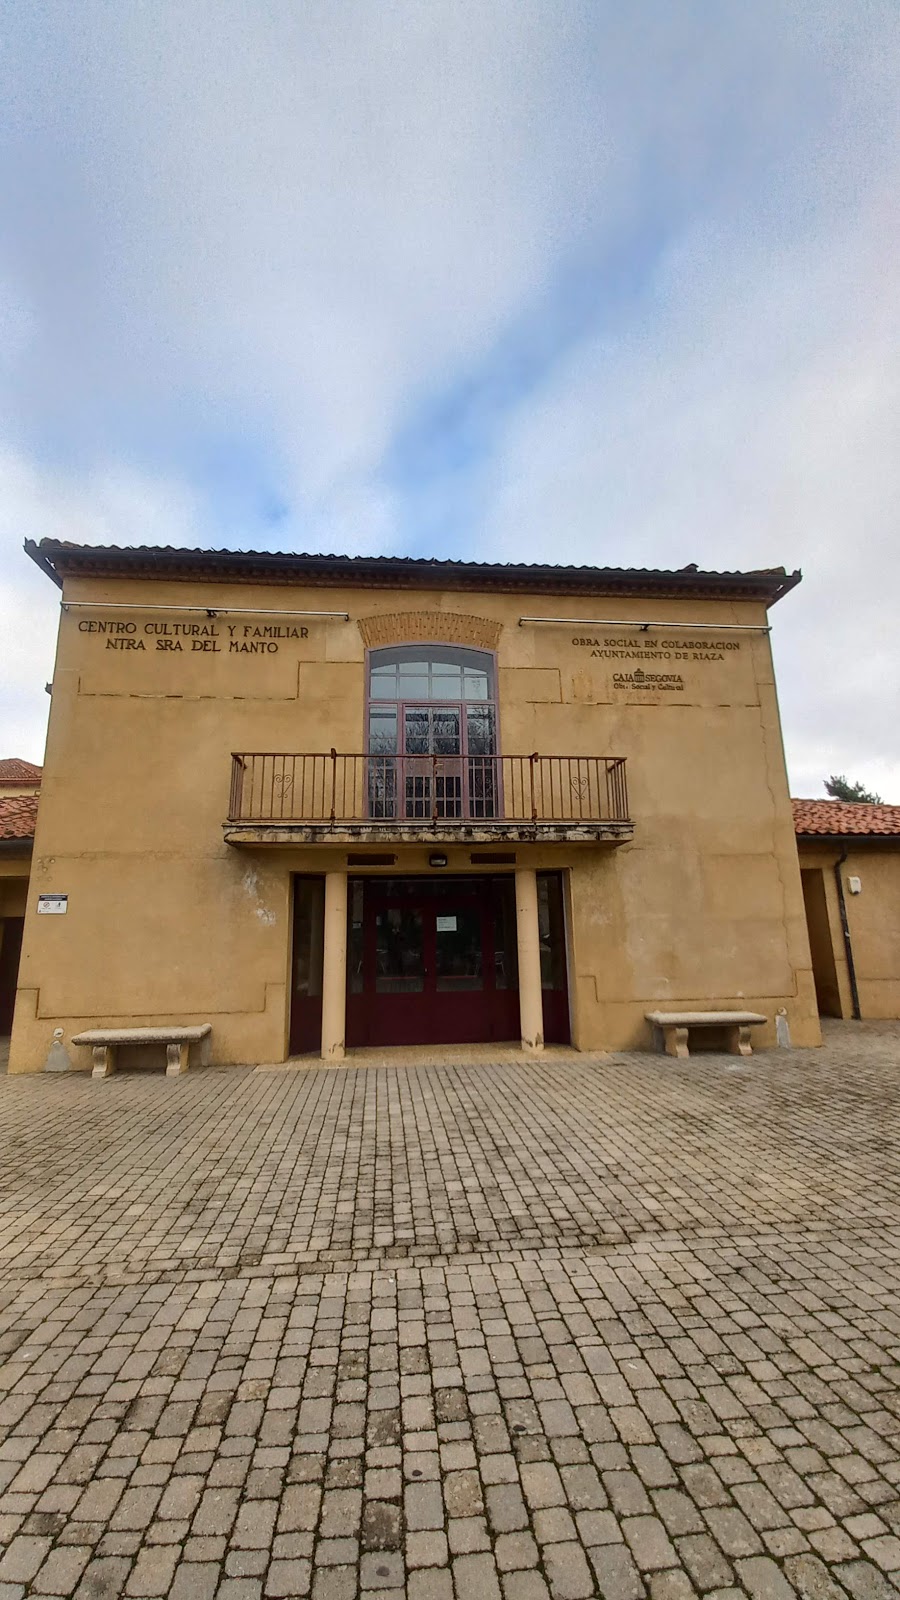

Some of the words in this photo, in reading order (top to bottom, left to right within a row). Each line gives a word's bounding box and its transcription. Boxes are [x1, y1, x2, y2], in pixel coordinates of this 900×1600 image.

[78, 621, 137, 634] CENTRO
[144, 623, 220, 636] CULTURAL
[227, 625, 237, 637] Y
[243, 626, 309, 638] FAMILIAR
[105, 639, 146, 650] NTRA
[156, 639, 183, 651] SRA
[191, 640, 221, 652] DEL
[229, 641, 279, 653] MANTO
[572, 638, 600, 647] OBRA
[604, 639, 641, 648] SOCIAL
[644, 640, 658, 648] EN
[661, 640, 740, 650] COLABORACION
[590, 650, 671, 659] AYUNTAMIENTO
[675, 652, 688, 660] DE
[645, 674, 683, 682] SEGOVIA
